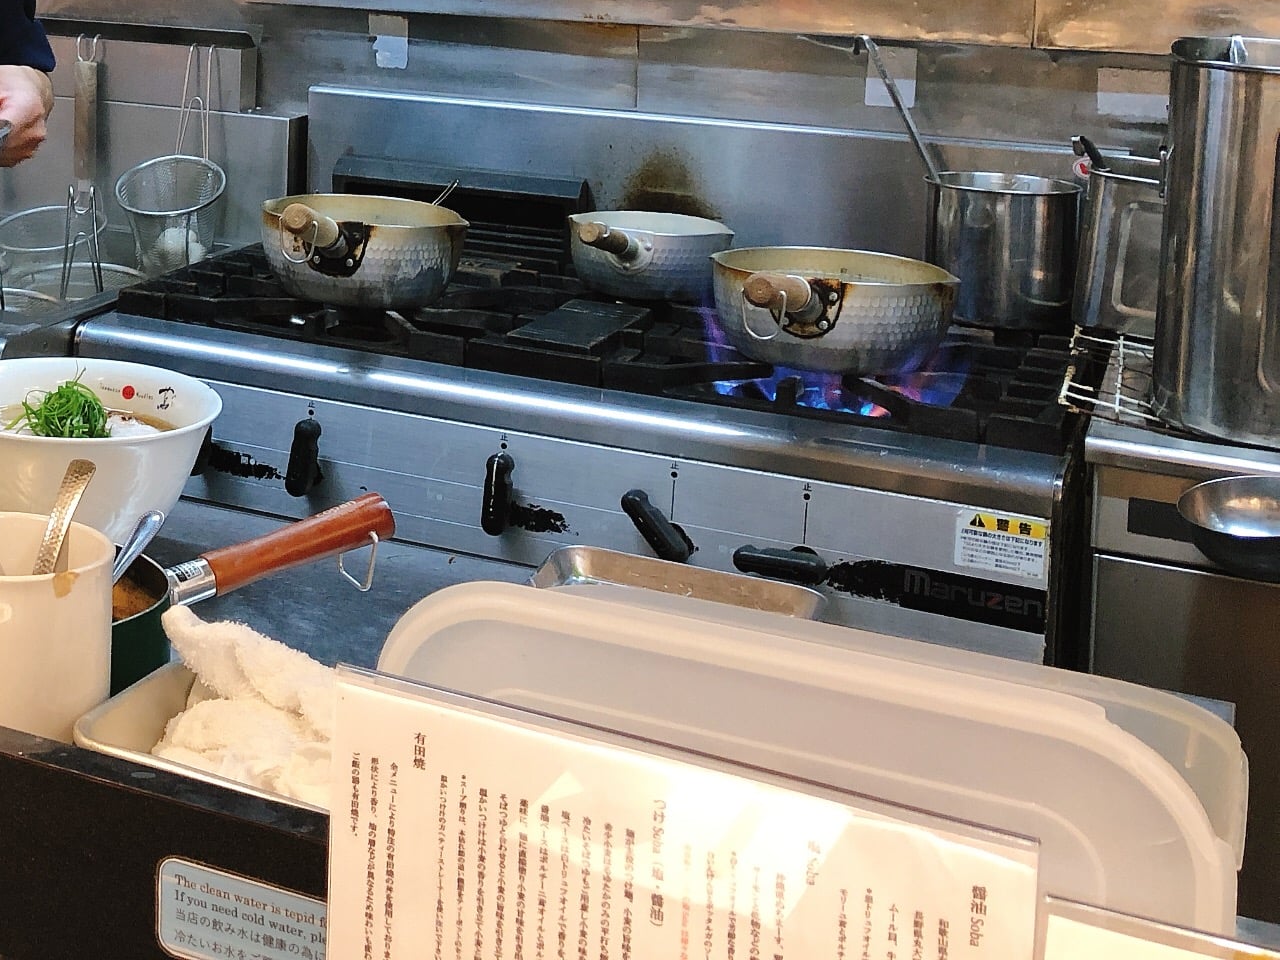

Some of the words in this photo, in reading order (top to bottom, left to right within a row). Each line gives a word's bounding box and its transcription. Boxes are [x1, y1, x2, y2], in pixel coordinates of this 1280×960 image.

[996, 518, 1031, 536] 警告
[412, 732, 427, 771] 有田焼
[652, 826, 665, 854] Soba
[174, 873, 197, 890] The
[200, 882, 231, 900] clean
[234, 893, 268, 911] water
[271, 901, 281, 915] is
[285, 907, 315, 925] tepid
[174, 889, 186, 902] If
[186, 895, 207, 909] you
[211, 903, 238, 918] need
[241, 912, 265, 926] cold
[269, 919, 306, 940] water,
[970, 885, 987, 915] 醤油
[970, 916, 984, 947] Soba
